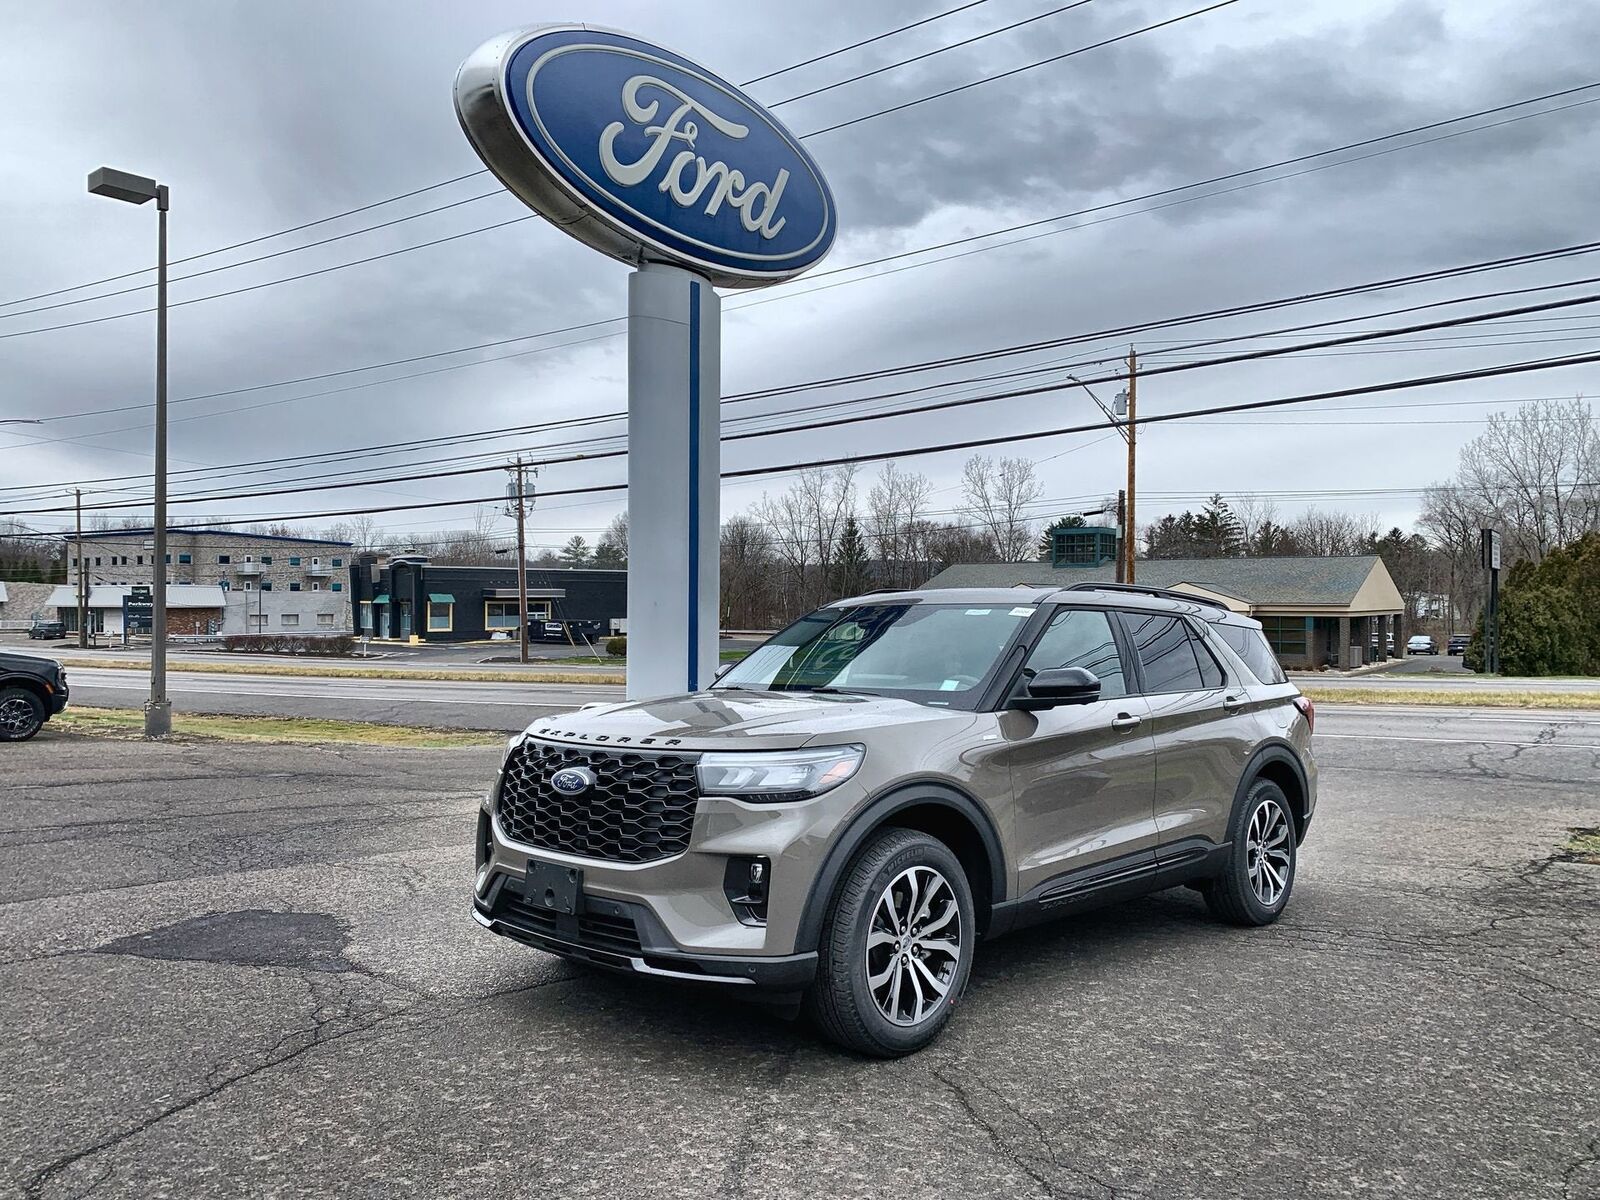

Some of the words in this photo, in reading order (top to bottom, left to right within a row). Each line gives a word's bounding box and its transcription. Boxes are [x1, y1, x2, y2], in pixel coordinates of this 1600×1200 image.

[599, 75, 790, 240] Ford
[538, 728, 681, 746] EXPLORER
[557, 774, 579, 789] Ford
